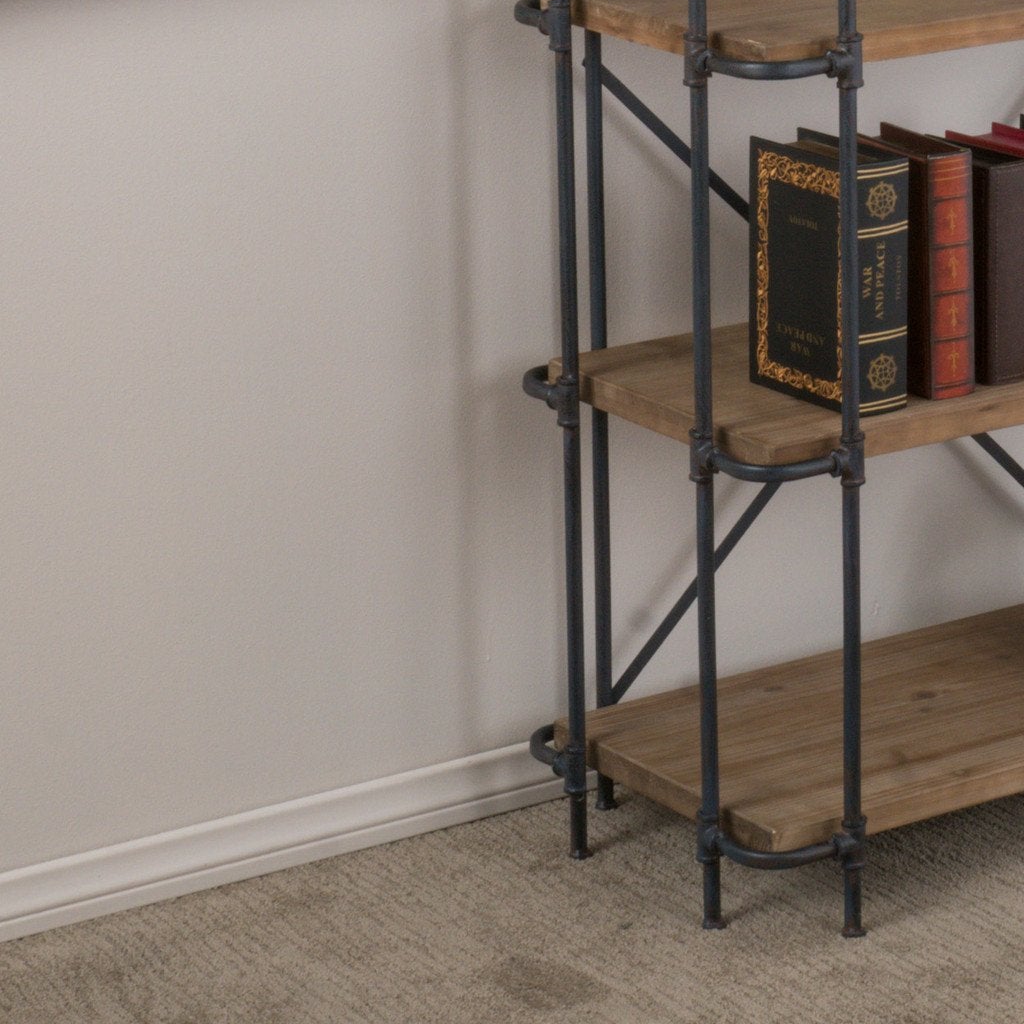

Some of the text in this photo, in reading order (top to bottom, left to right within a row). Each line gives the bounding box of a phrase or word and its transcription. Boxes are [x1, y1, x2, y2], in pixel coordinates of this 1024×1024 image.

[862, 266, 873, 300] WAR
[875, 240, 886, 321] AND PEACE
